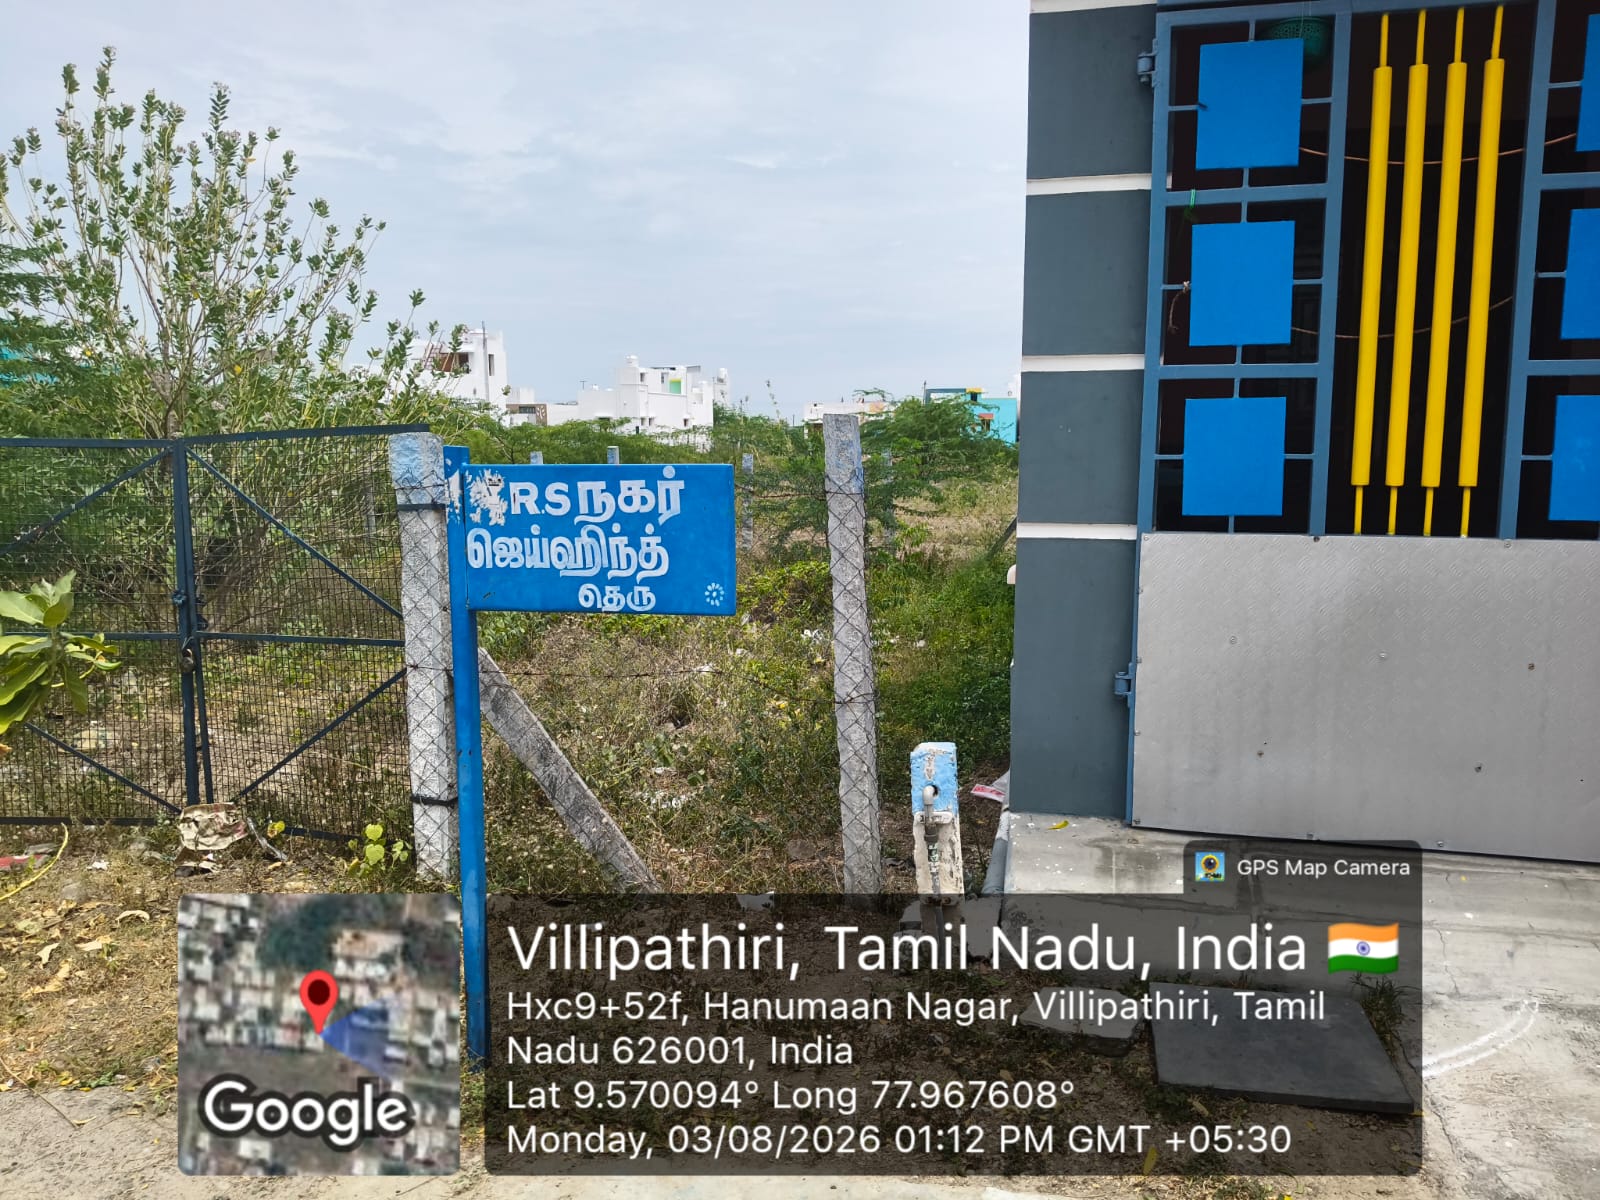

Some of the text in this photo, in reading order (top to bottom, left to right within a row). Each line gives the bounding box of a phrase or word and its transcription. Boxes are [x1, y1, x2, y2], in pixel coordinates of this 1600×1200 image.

[574, 465, 685, 526] நகர்
[466, 522, 670, 584] ஜெய்ஹிந்த்
[578, 583, 656, 612] தெரு
